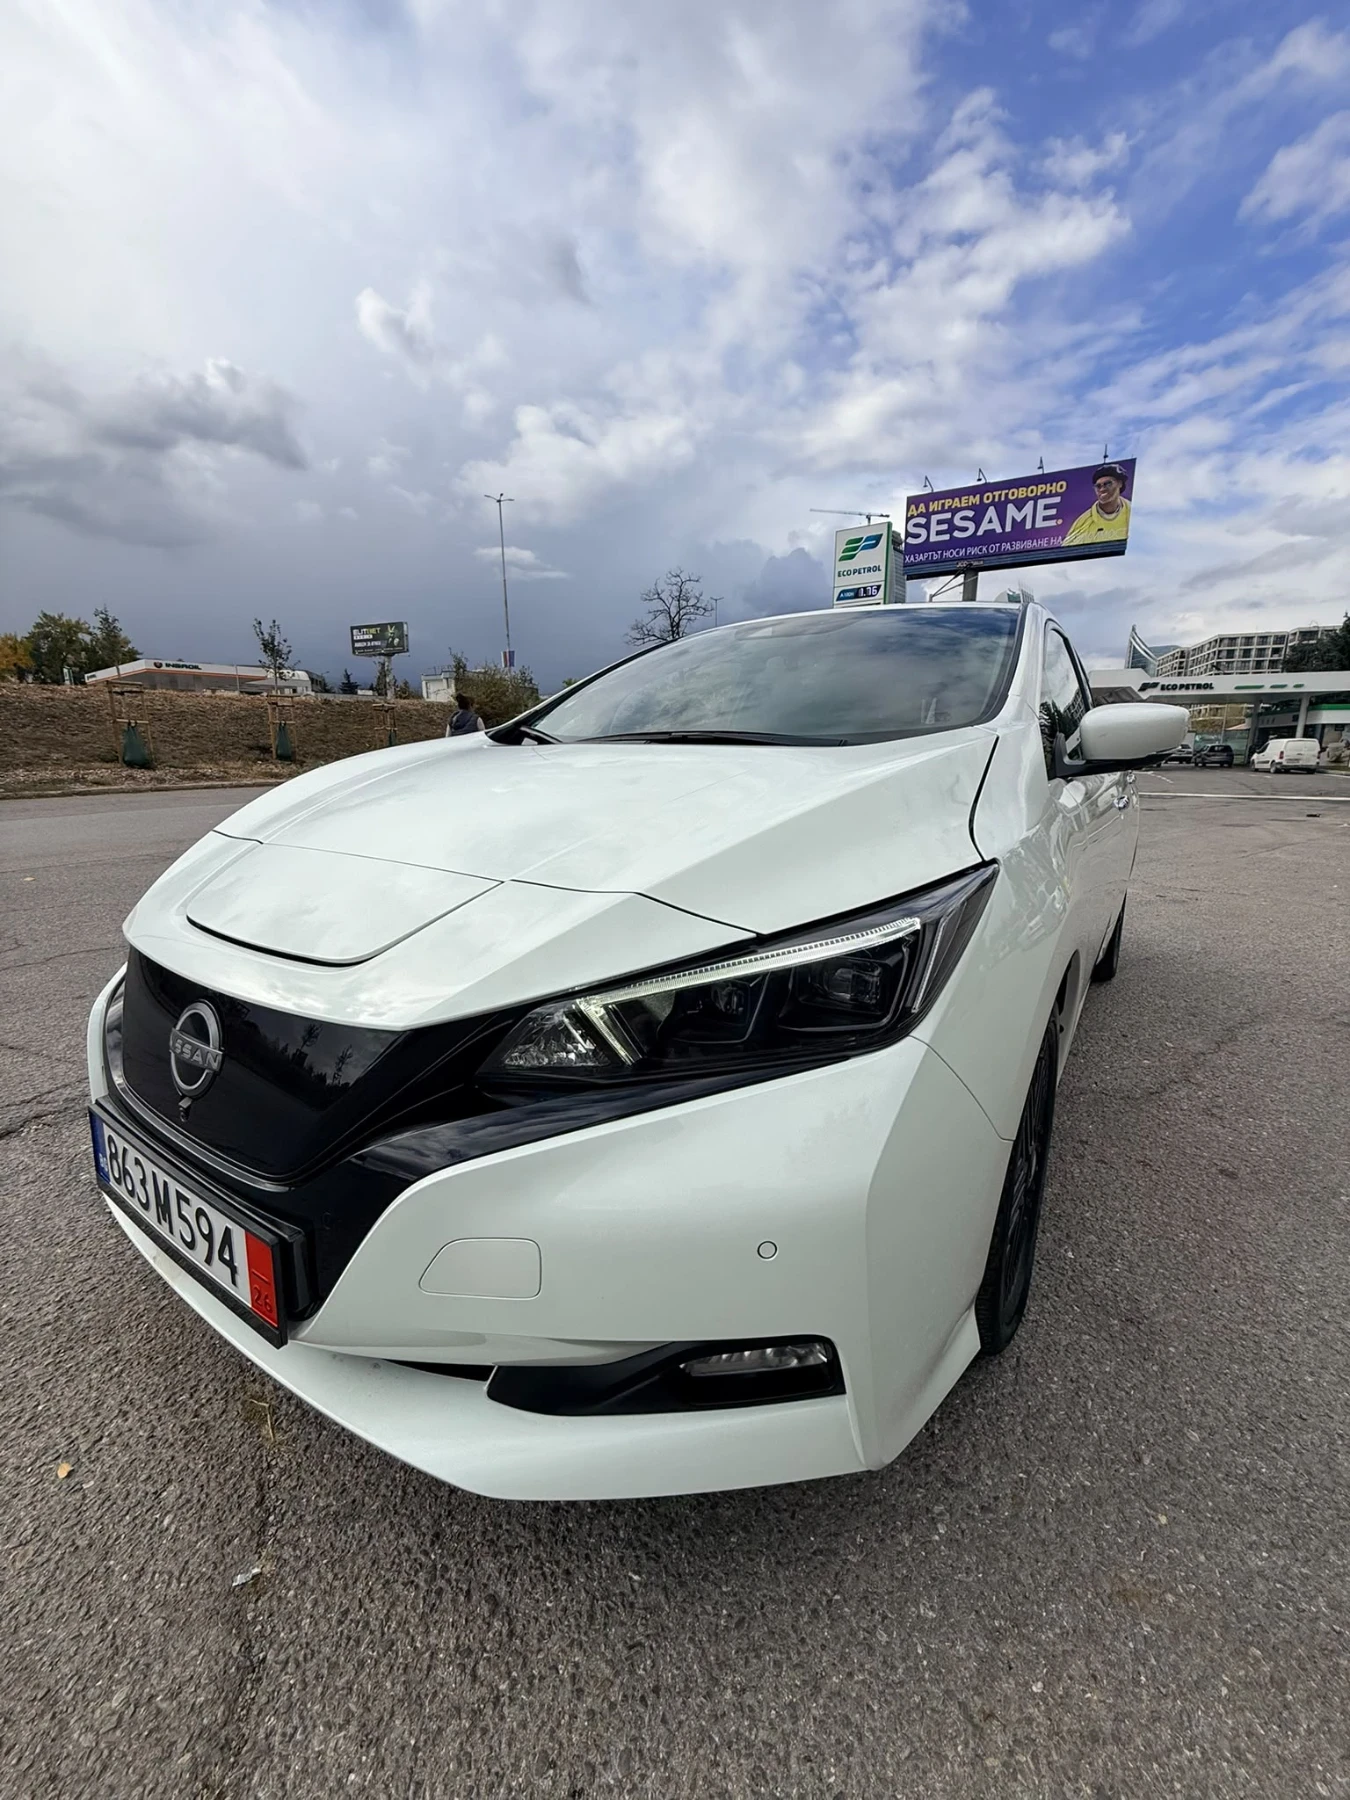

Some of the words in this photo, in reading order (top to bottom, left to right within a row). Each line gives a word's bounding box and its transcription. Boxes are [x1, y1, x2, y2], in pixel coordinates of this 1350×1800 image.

[907, 504, 926, 517] ДА
[929, 494, 980, 512] ИГРАЕМ
[983, 480, 1067, 504] ОТГОВОРНО
[904, 550, 942, 563] ХАЗАРТЪТ
[943, 548, 965, 559] НОСИ
[967, 545, 988, 555] РИСК
[988, 543, 1000, 553] ОТ
[1001, 537, 1049, 552] РАЗВИВАНЕ
[1050, 536, 1063, 546] НА
[174, 1038, 222, 1070] SSAN
[252, 1284, 273, 1313] 26
